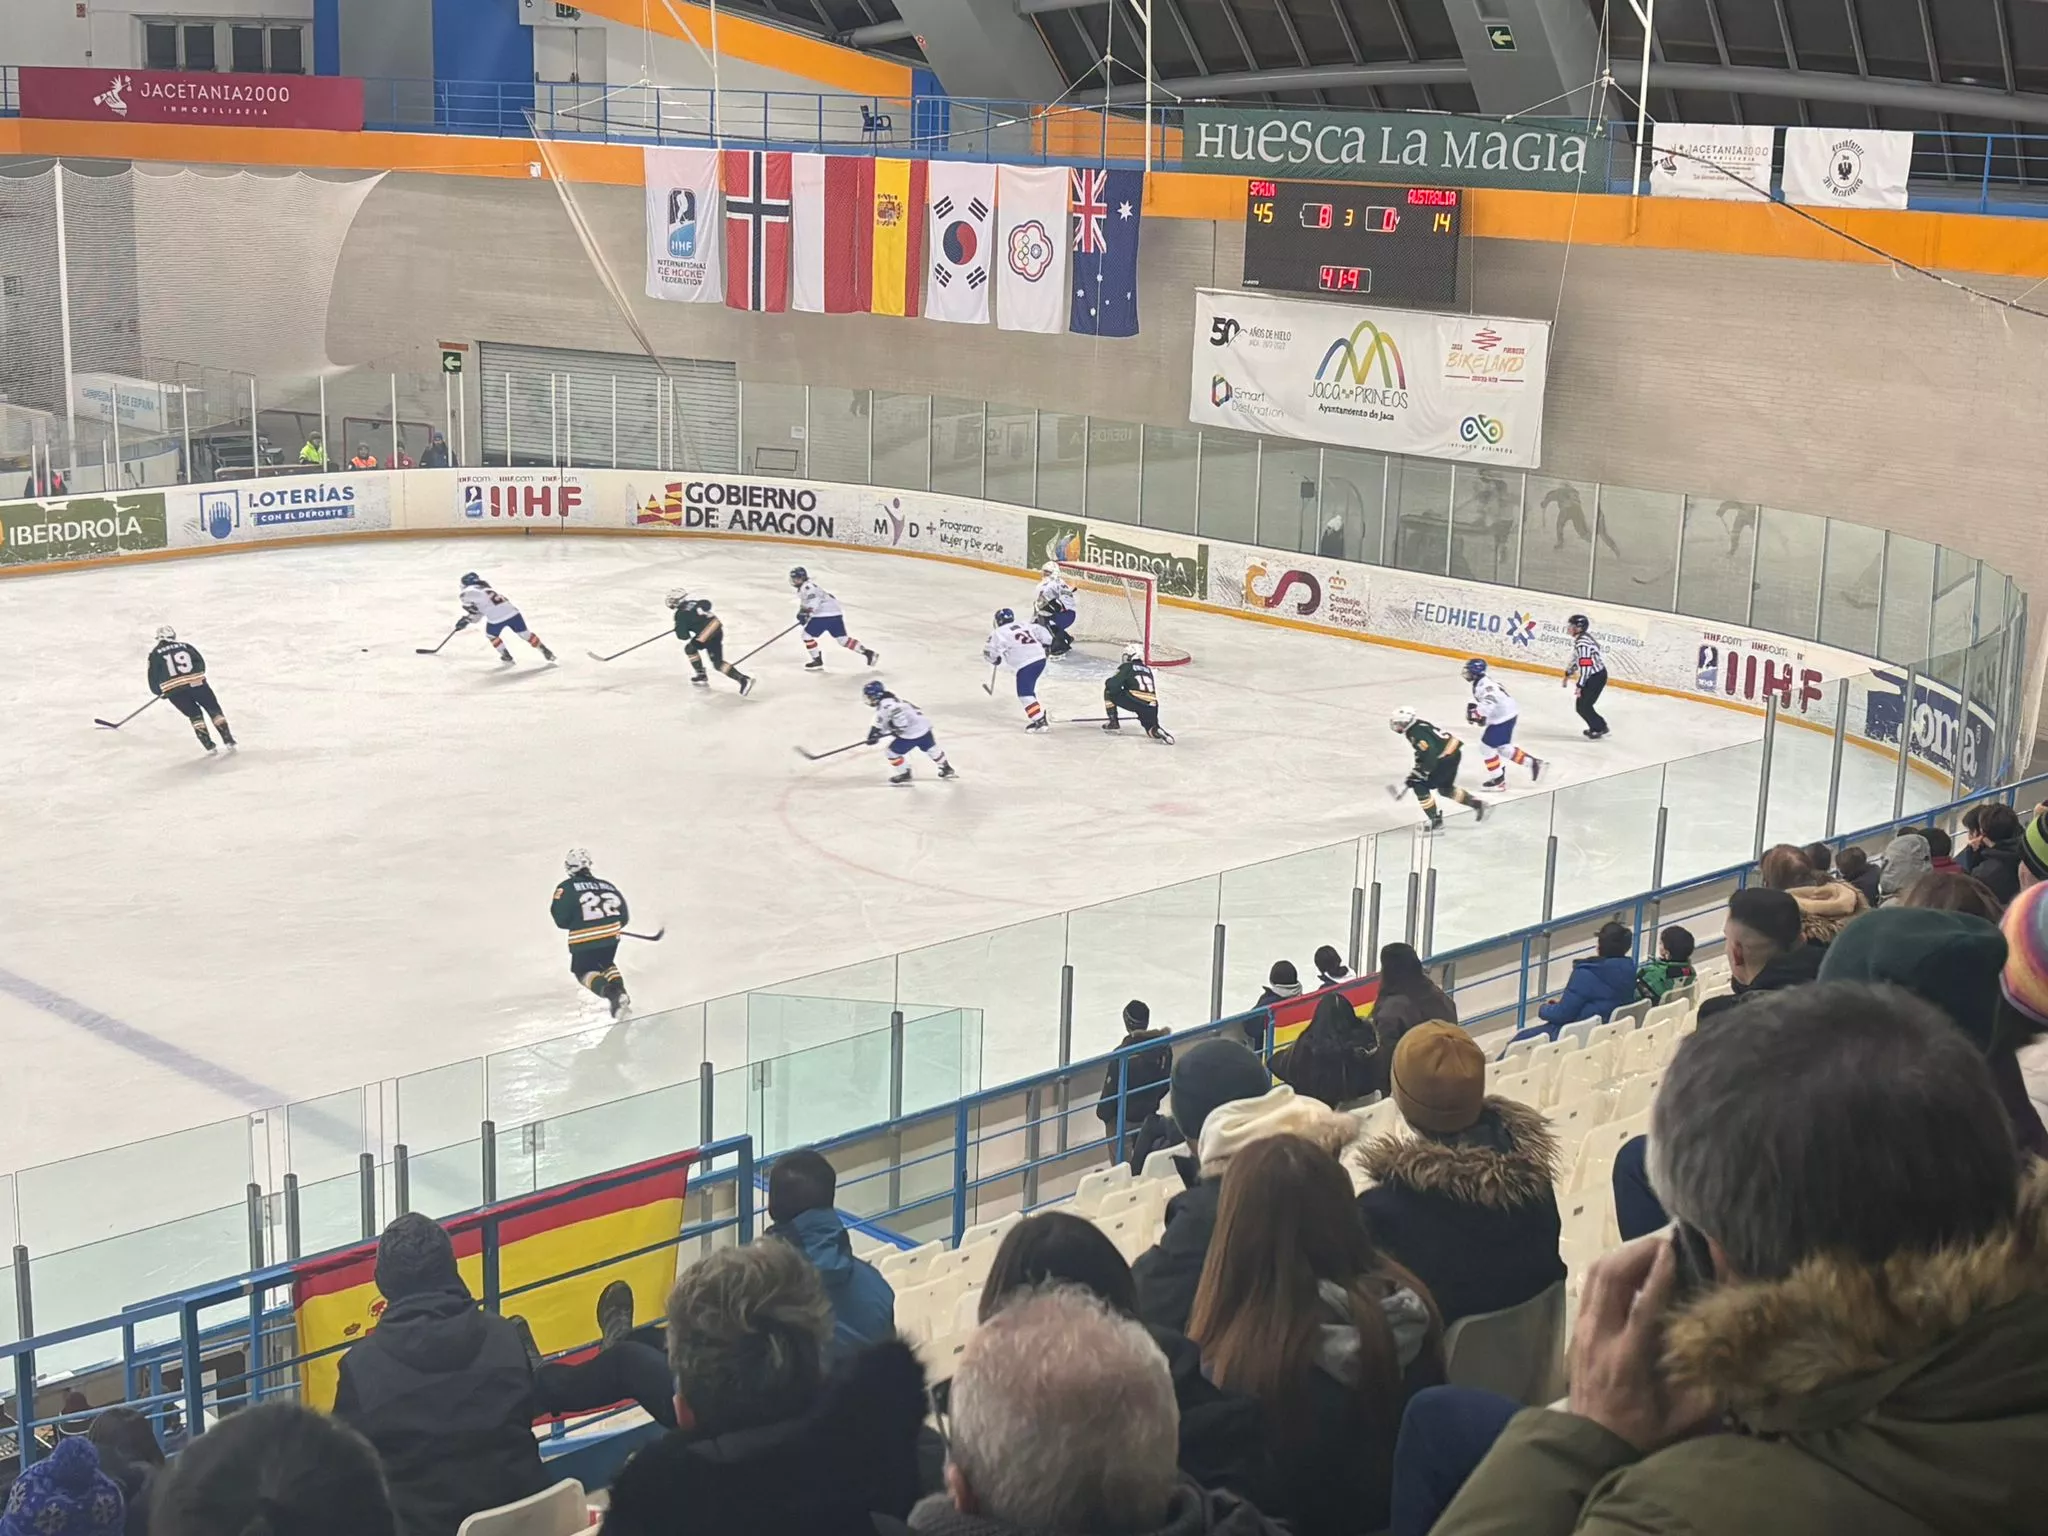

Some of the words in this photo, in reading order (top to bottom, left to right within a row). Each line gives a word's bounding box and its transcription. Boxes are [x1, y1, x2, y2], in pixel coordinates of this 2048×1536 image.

[140, 82, 290, 103] JACETANIA2000
[1407, 188, 1457, 206] AUSTRALIA
[1253, 202, 1274, 225] 45
[1343, 208, 1354, 227] 3
[1433, 212, 1451, 233] 14
[1446, 352, 1524, 374] BIKELAND
[1234, 387, 1265, 402] Smart
[1379, 411, 1394, 421] Jaca
[248, 485, 355, 508] LOTERÍAS
[490, 486, 582, 517] IIHF
[684, 481, 817, 512] GOBIERNO
[261, 513, 281, 522] CON
[285, 512, 295, 520] EL
[298, 508, 344, 519] DEPORTE
[685, 507, 720, 529] DE
[9, 515, 143, 546] IBERDROLA
[1089, 544, 1190, 583] IBERDROLA
[1415, 602, 1500, 633] FEDHIELO
[1539, 634, 1573, 647] DEPORTE
[1703, 632, 1742, 647] IIHF.com
[162, 650, 194, 677] 19
[1725, 651, 1823, 714] IIHF
